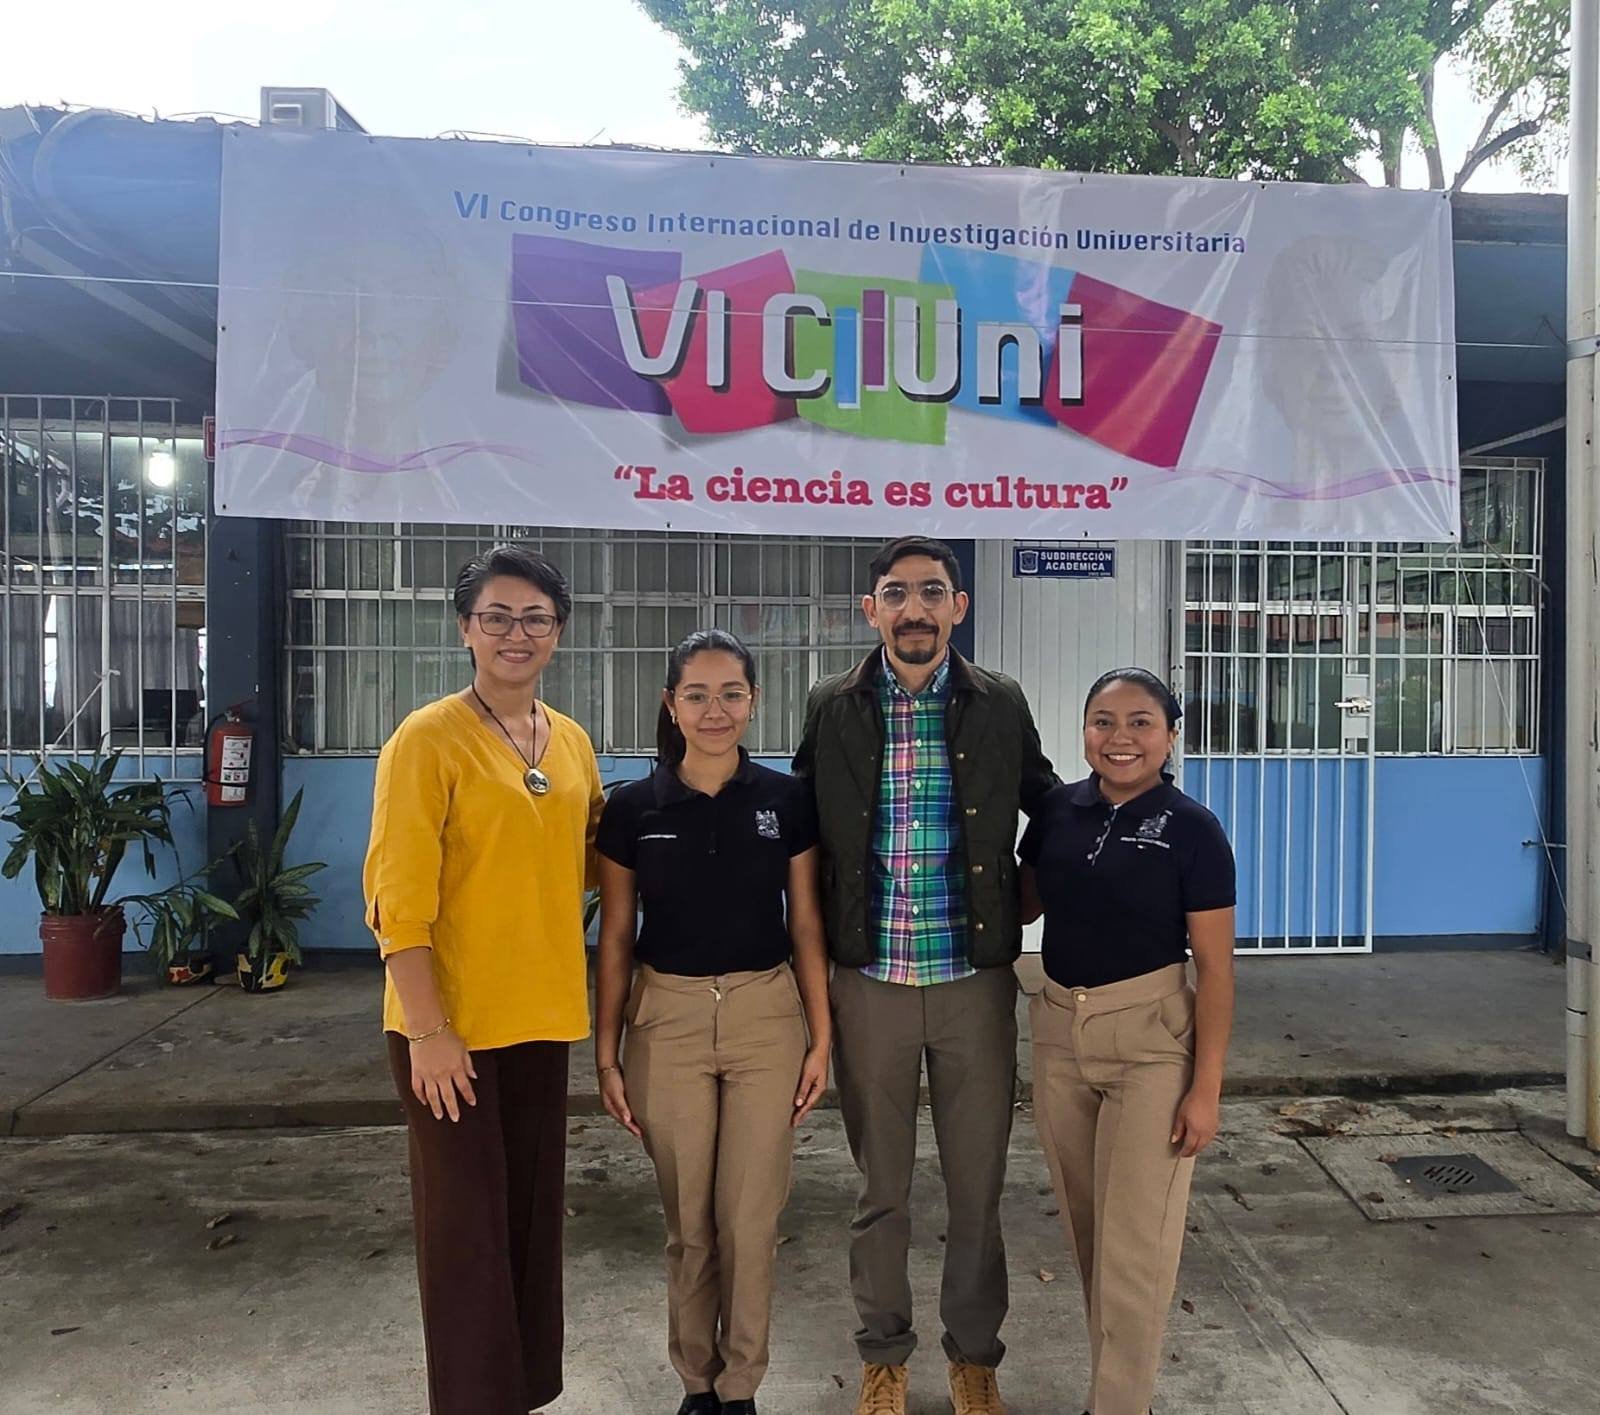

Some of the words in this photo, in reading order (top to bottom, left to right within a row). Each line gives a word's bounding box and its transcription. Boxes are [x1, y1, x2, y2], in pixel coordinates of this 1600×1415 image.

[453, 190, 489, 220] VI
[499, 200, 637, 232] Congreso
[647, 212, 840, 239] Internacional
[848, 219, 881, 241] de
[888, 221, 1069, 250] Investigación
[1076, 229, 1246, 254] Universitaria
[605, 274, 728, 392] VI
[613, 465, 694, 501] “La
[705, 466, 874, 506] ciencia
[884, 481, 932, 507] es
[944, 475, 1129, 510] cultura”
[1040, 550, 1112, 561] SUBDIRECCIÓN
[1045, 562, 1105, 571] ACADEMICA
